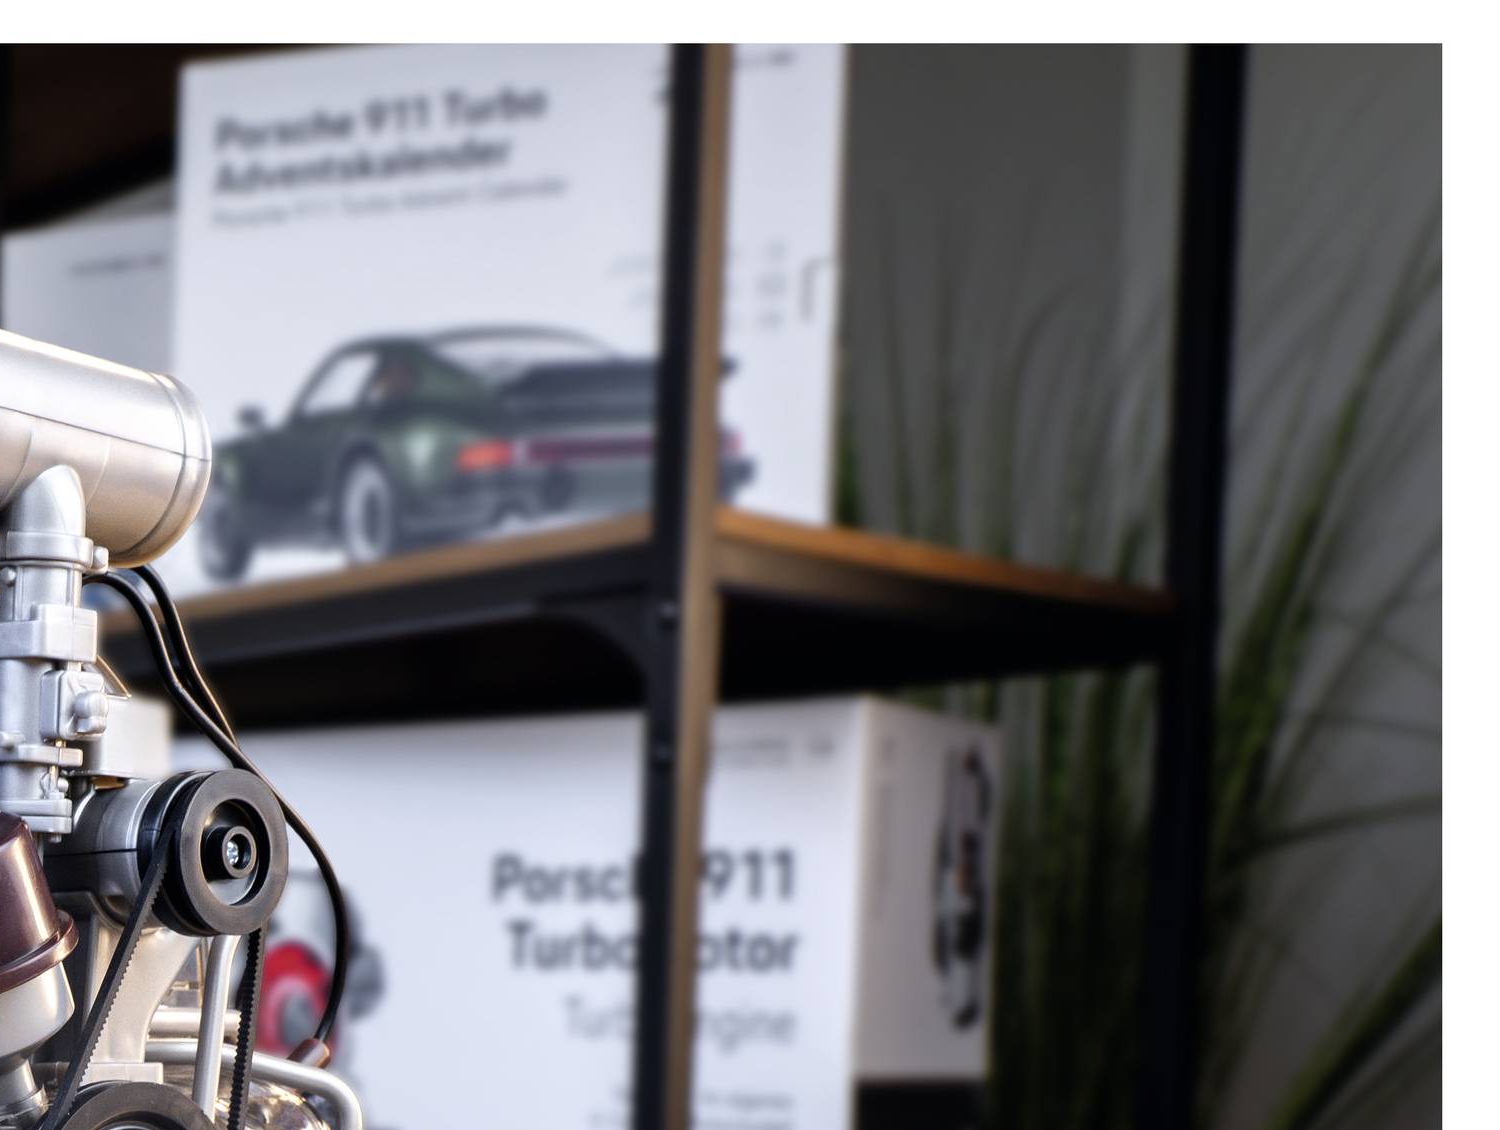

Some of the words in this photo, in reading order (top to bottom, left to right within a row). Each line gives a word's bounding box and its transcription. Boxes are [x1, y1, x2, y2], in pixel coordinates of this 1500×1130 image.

[214, 109, 352, 148] Porsche
[365, 95, 431, 135] 911
[444, 88, 549, 128] Turbo
[214, 136, 512, 195] Adventskalender
[492, 852, 640, 903] Porsc
[701, 848, 795, 902] 911
[505, 918, 800, 973] Turbootor
